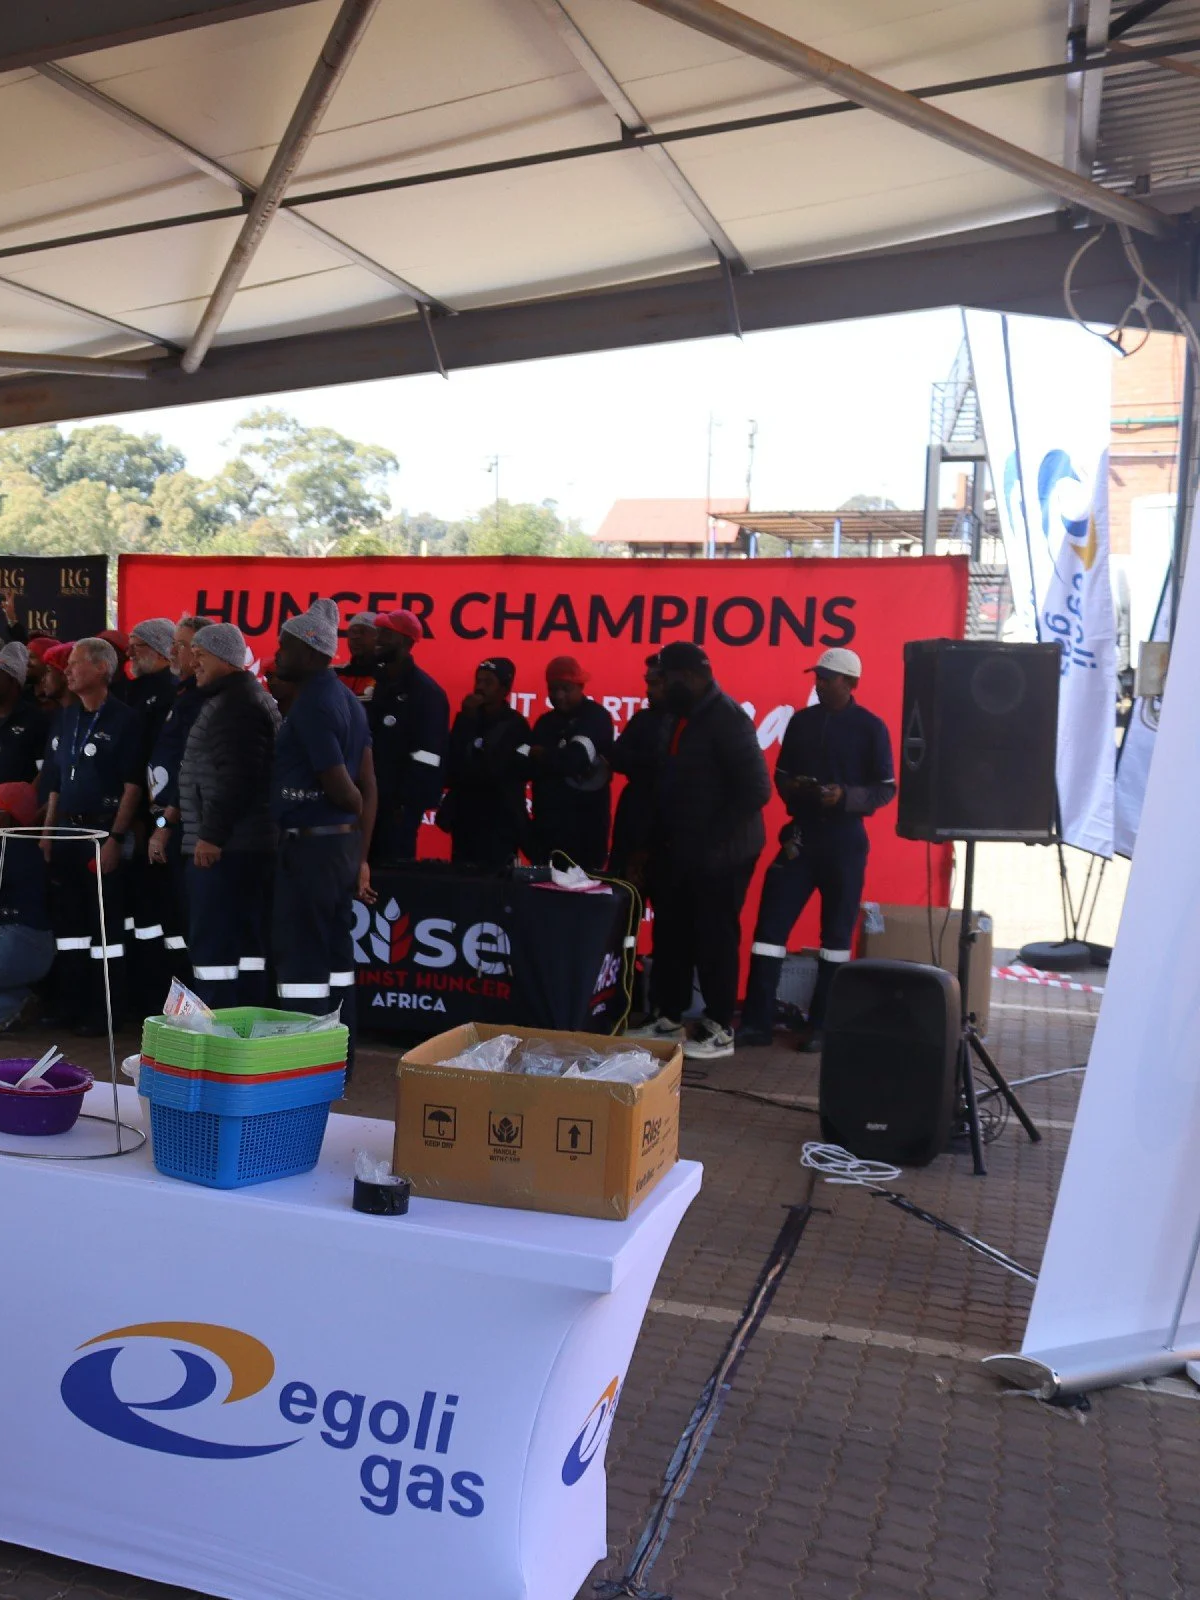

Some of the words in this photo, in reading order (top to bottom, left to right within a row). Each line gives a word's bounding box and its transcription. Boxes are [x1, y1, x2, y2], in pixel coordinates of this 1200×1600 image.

[61, 568, 90, 588] RG
[28, 610, 57, 629] RG
[450, 591, 857, 647] CHAMPIONS
[416, 969, 513, 1000] HUNGER
[371, 991, 447, 1013] AFRICA
[424, 1140, 441, 1148] KEEP
[441, 1141, 454, 1149] DRY
[493, 1148, 517, 1156] HANDLE
[278, 1379, 459, 1454] egoli
[359, 1454, 486, 1518] gas
